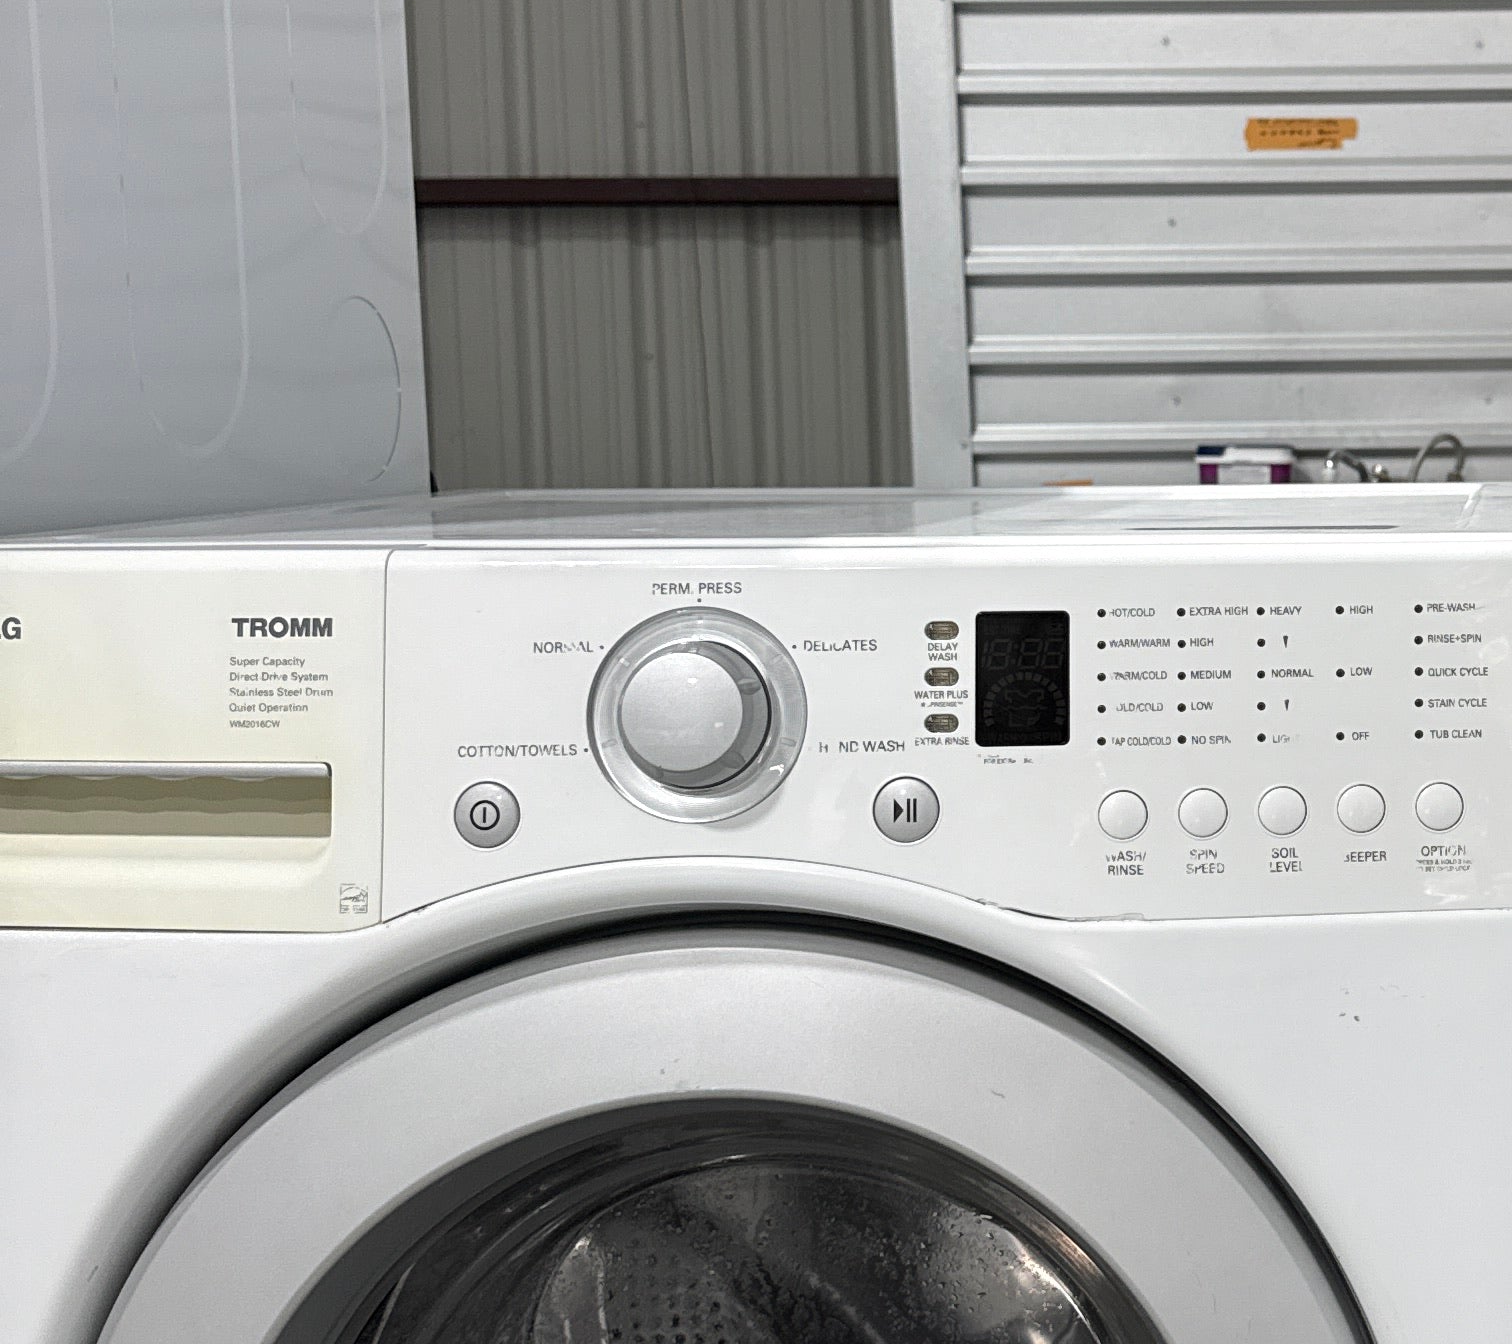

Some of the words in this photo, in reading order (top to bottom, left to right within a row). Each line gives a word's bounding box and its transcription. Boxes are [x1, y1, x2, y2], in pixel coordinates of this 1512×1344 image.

[652, 583, 694, 595] PERM.
[699, 582, 742, 594] PRESS
[1189, 607, 1222, 616] EXTRA
[1224, 607, 1249, 616] HIGH
[1270, 606, 1302, 616] HEAVY
[1350, 605, 1373, 615] HIGH
[1427, 603, 1476, 613] PRE-WASH
[0, 616, 21, 640] G
[231, 616, 333, 638] TROMM
[1109, 638, 1171, 648] WARM/WARM
[1189, 638, 1214, 647] HIGH
[1427, 634, 1482, 644] RINSE+SPIN
[803, 639, 878, 652] DELICATES
[927, 642, 959, 652] DELAY
[229, 656, 260, 668] Super
[262, 656, 306, 668] Capacity
[927, 652, 959, 662] WASH
[1190, 670, 1232, 680] MEDIUM
[1271, 669, 1314, 678] NORMAL
[1350, 667, 1373, 677] LOW
[1427, 667, 1457, 677] QUICK
[1459, 667, 1489, 677] CYCLE
[229, 672, 259, 682] Direct
[261, 672, 288, 682] Drive
[291, 672, 329, 683] System
[229, 687, 275, 697] Stainless
[276, 687, 303, 697] Steel
[305, 687, 334, 697] Drum
[914, 691, 945, 700] WATER
[946, 690, 969, 700] PLUS
[229, 702, 257, 713] Quiet
[258, 702, 309, 713] Operation
[1115, 702, 1164, 713] OLD/COLD
[1190, 702, 1214, 711] LOW
[1428, 698, 1456, 708] STAIN
[1458, 698, 1488, 707] CYCLE
[1352, 732, 1370, 741] OFF
[1430, 730, 1450, 739] TUB
[1451, 729, 1483, 739] CLEAN
[914, 737, 943, 747] EXTRA
[944, 736, 970, 746] RINSE
[1191, 735, 1207, 745] NO
[457, 744, 578, 758] COTTON/TOWELS
[818, 740, 859, 754] HND
[862, 739, 905, 753] WASH
[1189, 849, 1218, 860] SPIN
[1271, 847, 1299, 859] SOIL
[1420, 845, 1466, 857] OPTION
[1107, 864, 1144, 876] RINSE
[1185, 863, 1225, 875] SPEED
[1269, 861, 1303, 873] LEVEL
